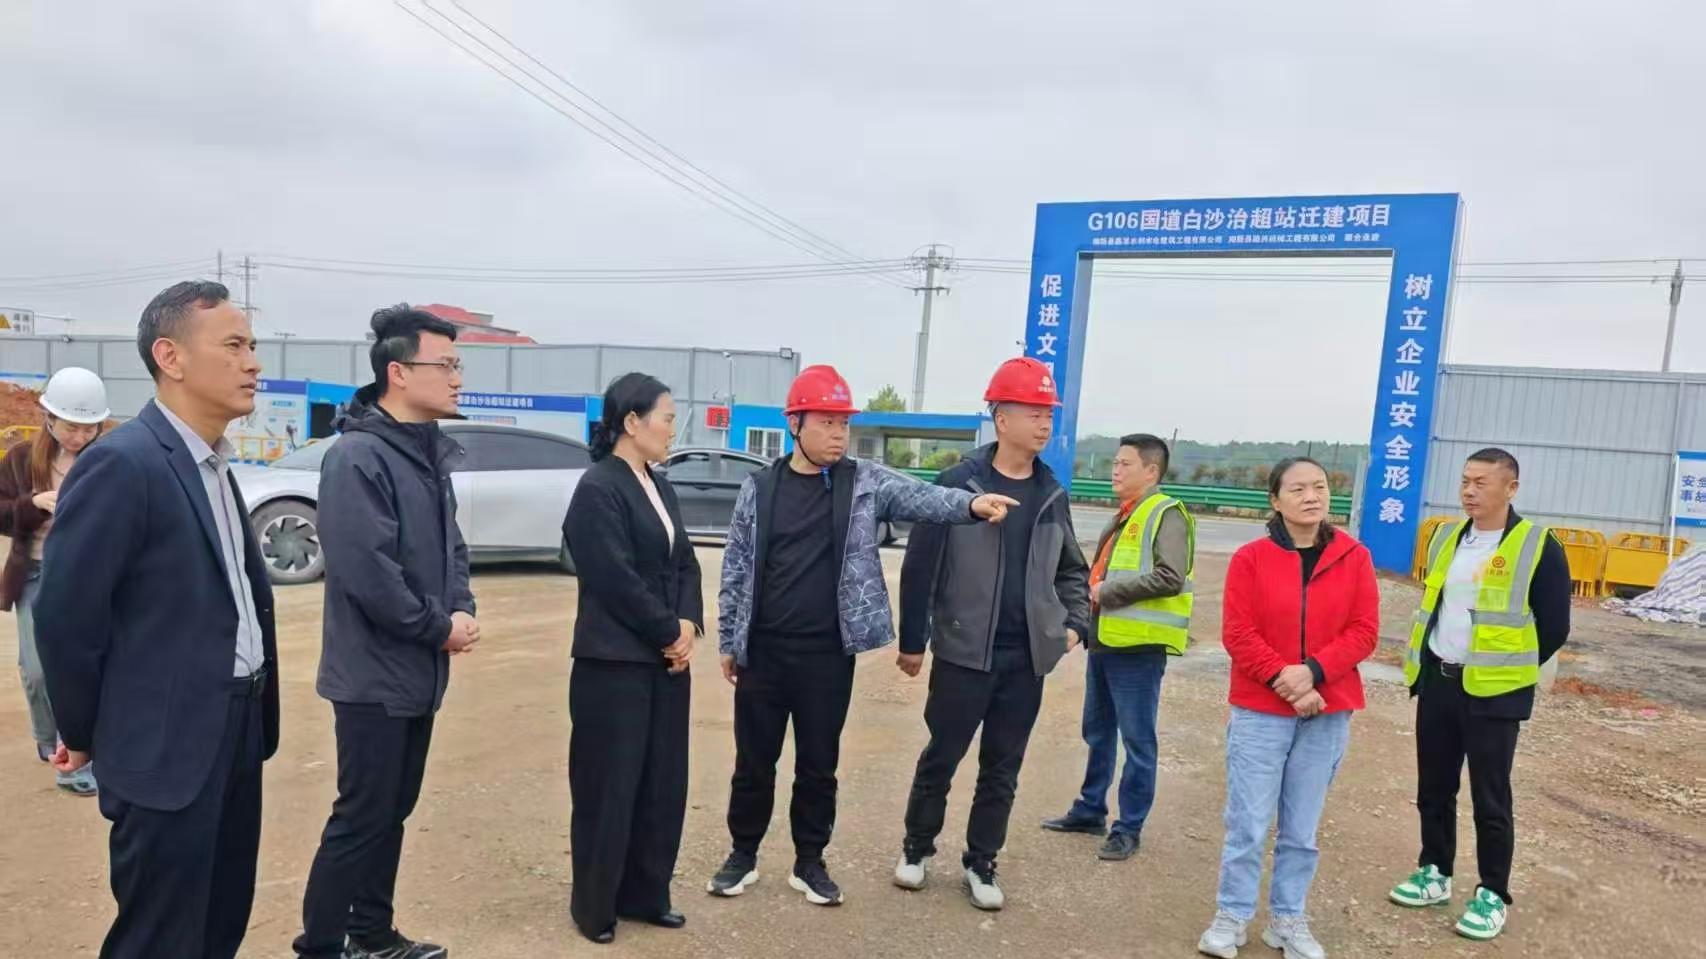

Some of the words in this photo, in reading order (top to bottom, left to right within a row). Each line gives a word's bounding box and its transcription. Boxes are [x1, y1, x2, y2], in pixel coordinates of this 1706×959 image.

[1088, 203, 1391, 231] G106国道白沙治超站迁建项目
[1036, 273, 1063, 376] 促进文
[1378, 273, 1434, 523] 树立企业安全形象
